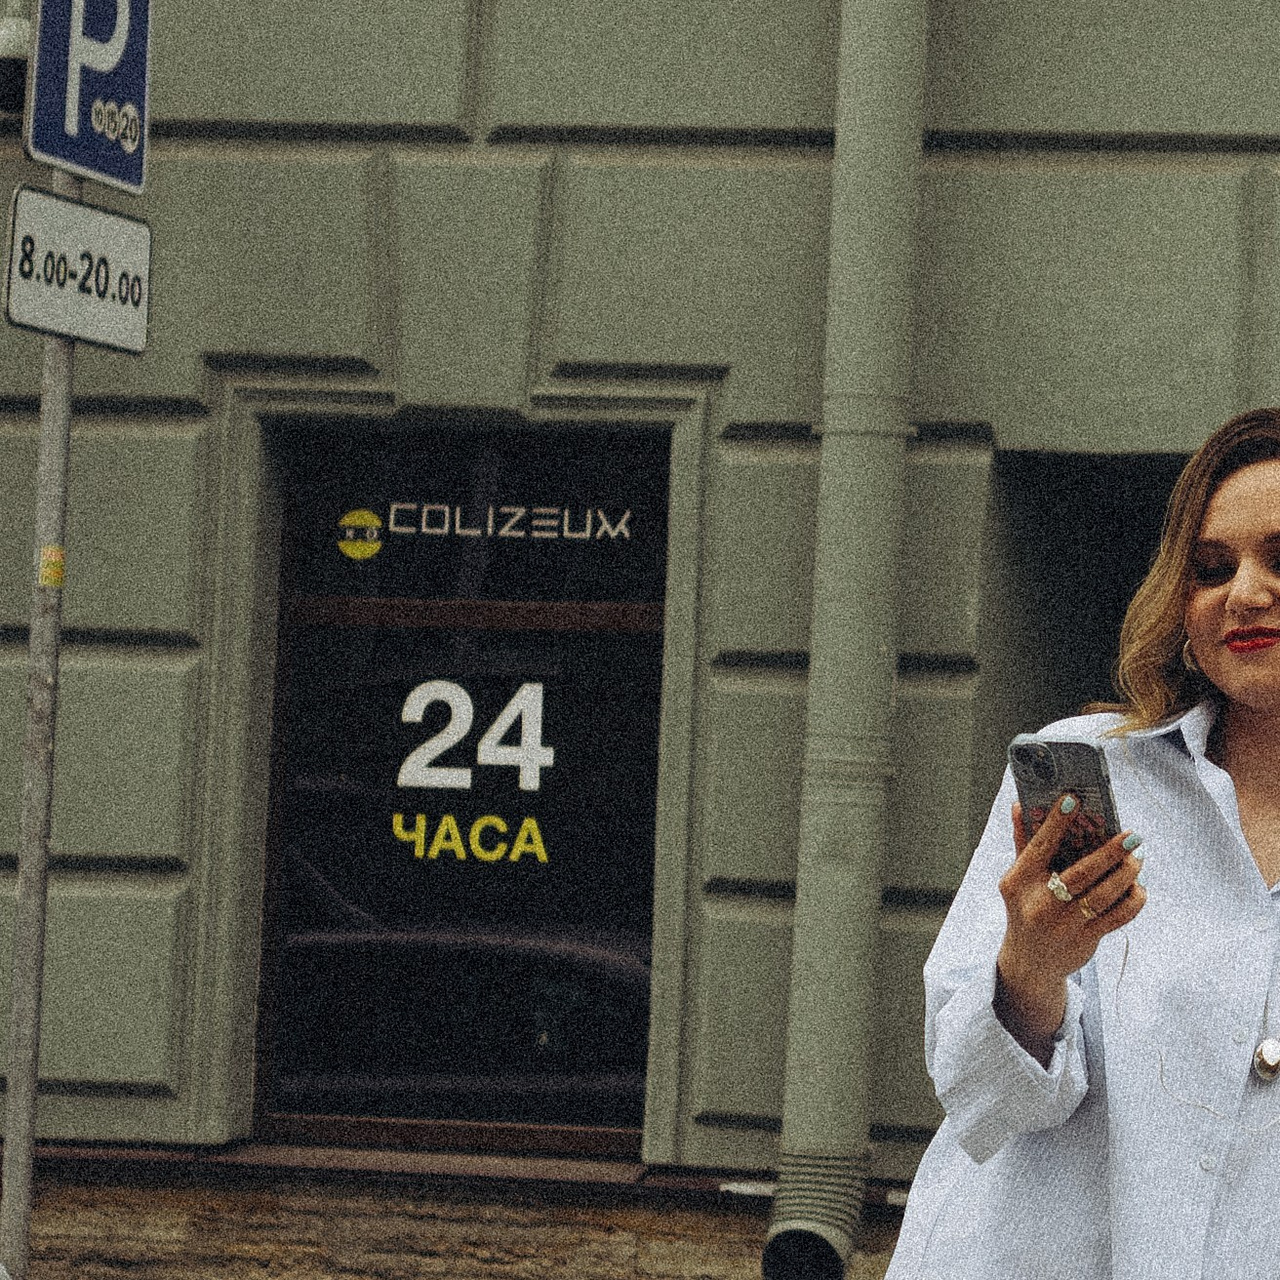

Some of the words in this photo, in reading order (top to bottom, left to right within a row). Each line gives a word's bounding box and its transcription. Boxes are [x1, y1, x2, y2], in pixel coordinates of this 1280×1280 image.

[19, 234, 142, 307] 8.00-20.00
[389, 503, 631, 539] COLIZEUM
[397, 679, 554, 791] 24
[392, 813, 548, 863] ЧАСА
